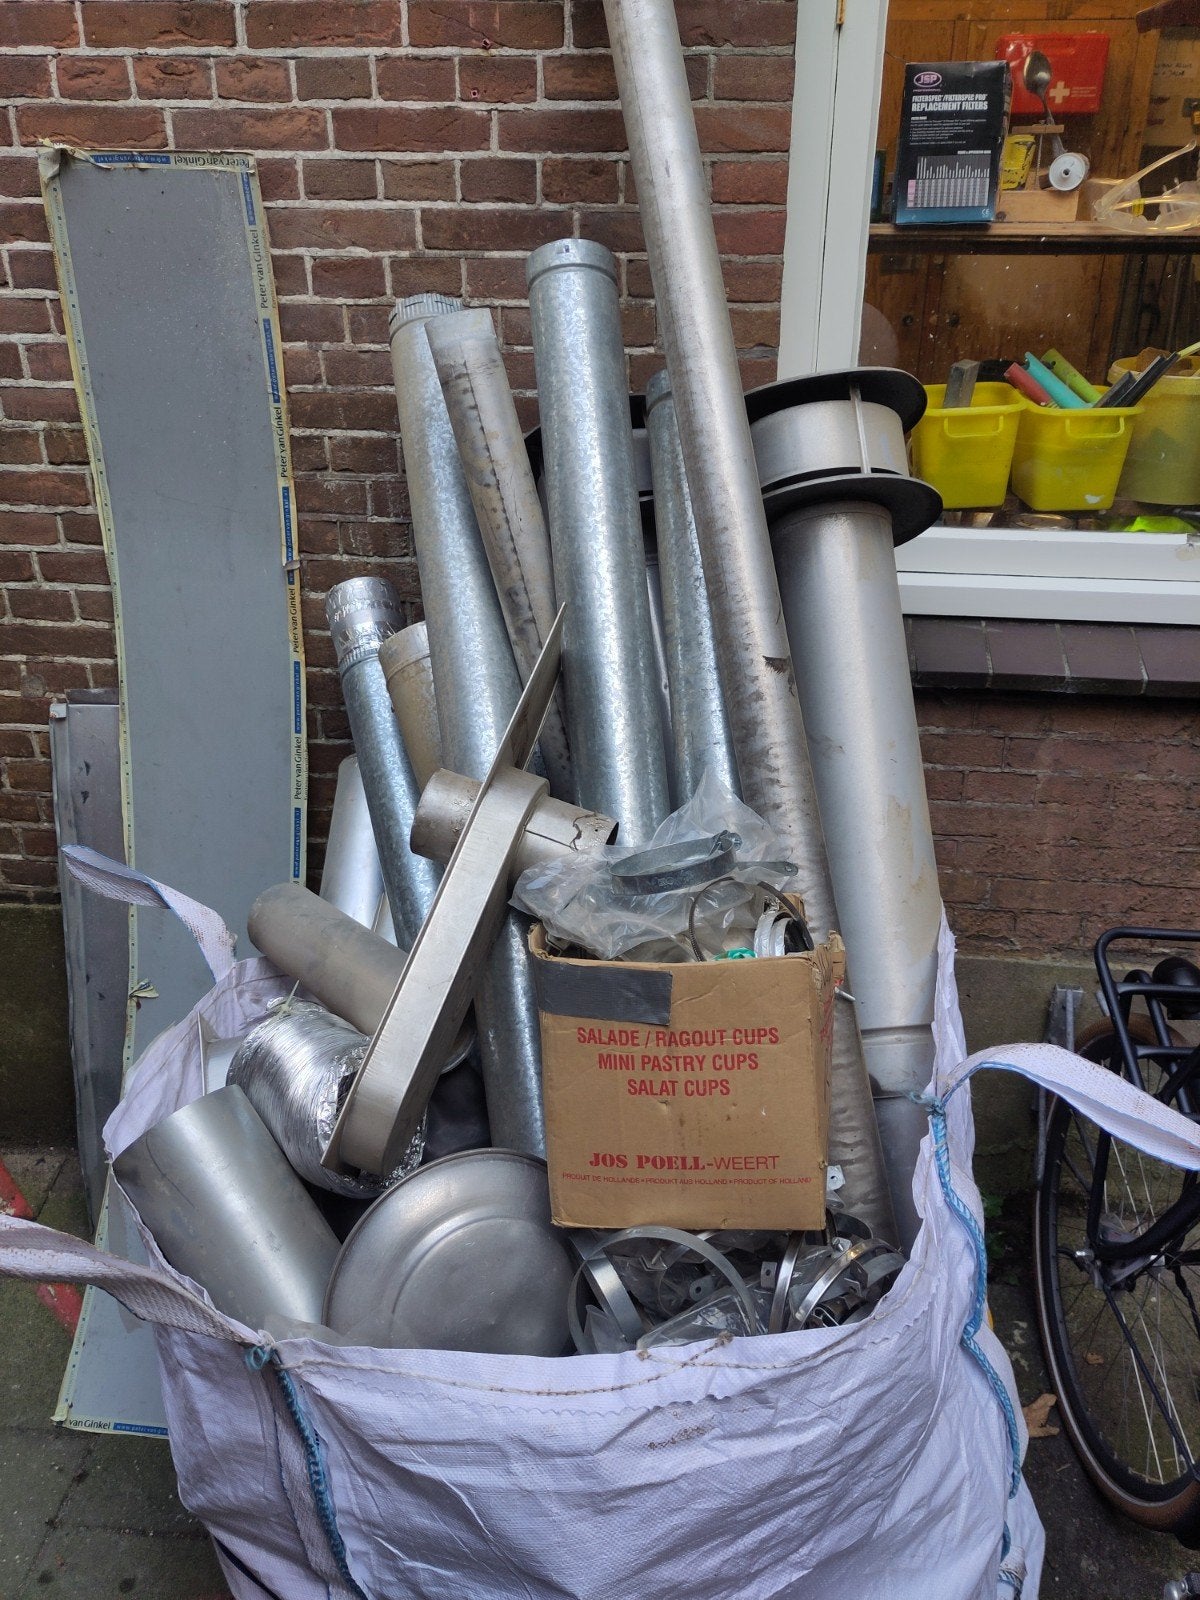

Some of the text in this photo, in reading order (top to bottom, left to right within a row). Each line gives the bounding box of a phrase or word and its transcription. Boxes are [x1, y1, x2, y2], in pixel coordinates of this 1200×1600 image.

[918, 74, 938, 84] JSP
[911, 101, 988, 111] REPLACEMENT FILTERS
[226, 158, 250, 168] Peter
[258, 283, 269, 309] Peter
[279, 455, 288, 478] Peter
[292, 632, 300, 653] Peter
[294, 779, 302, 800] Peter
[577, 1027, 780, 1048] SALADE / RAGOUT CUPS
[598, 1053, 759, 1072] MINI PASTRY CUPS
[627, 1078, 731, 1097] SALAT CUPS
[589, 1152, 629, 1169] JOS
[562, 1172, 591, 1182] PRODUIT
[645, 1177, 678, 1185] PRODUKT
